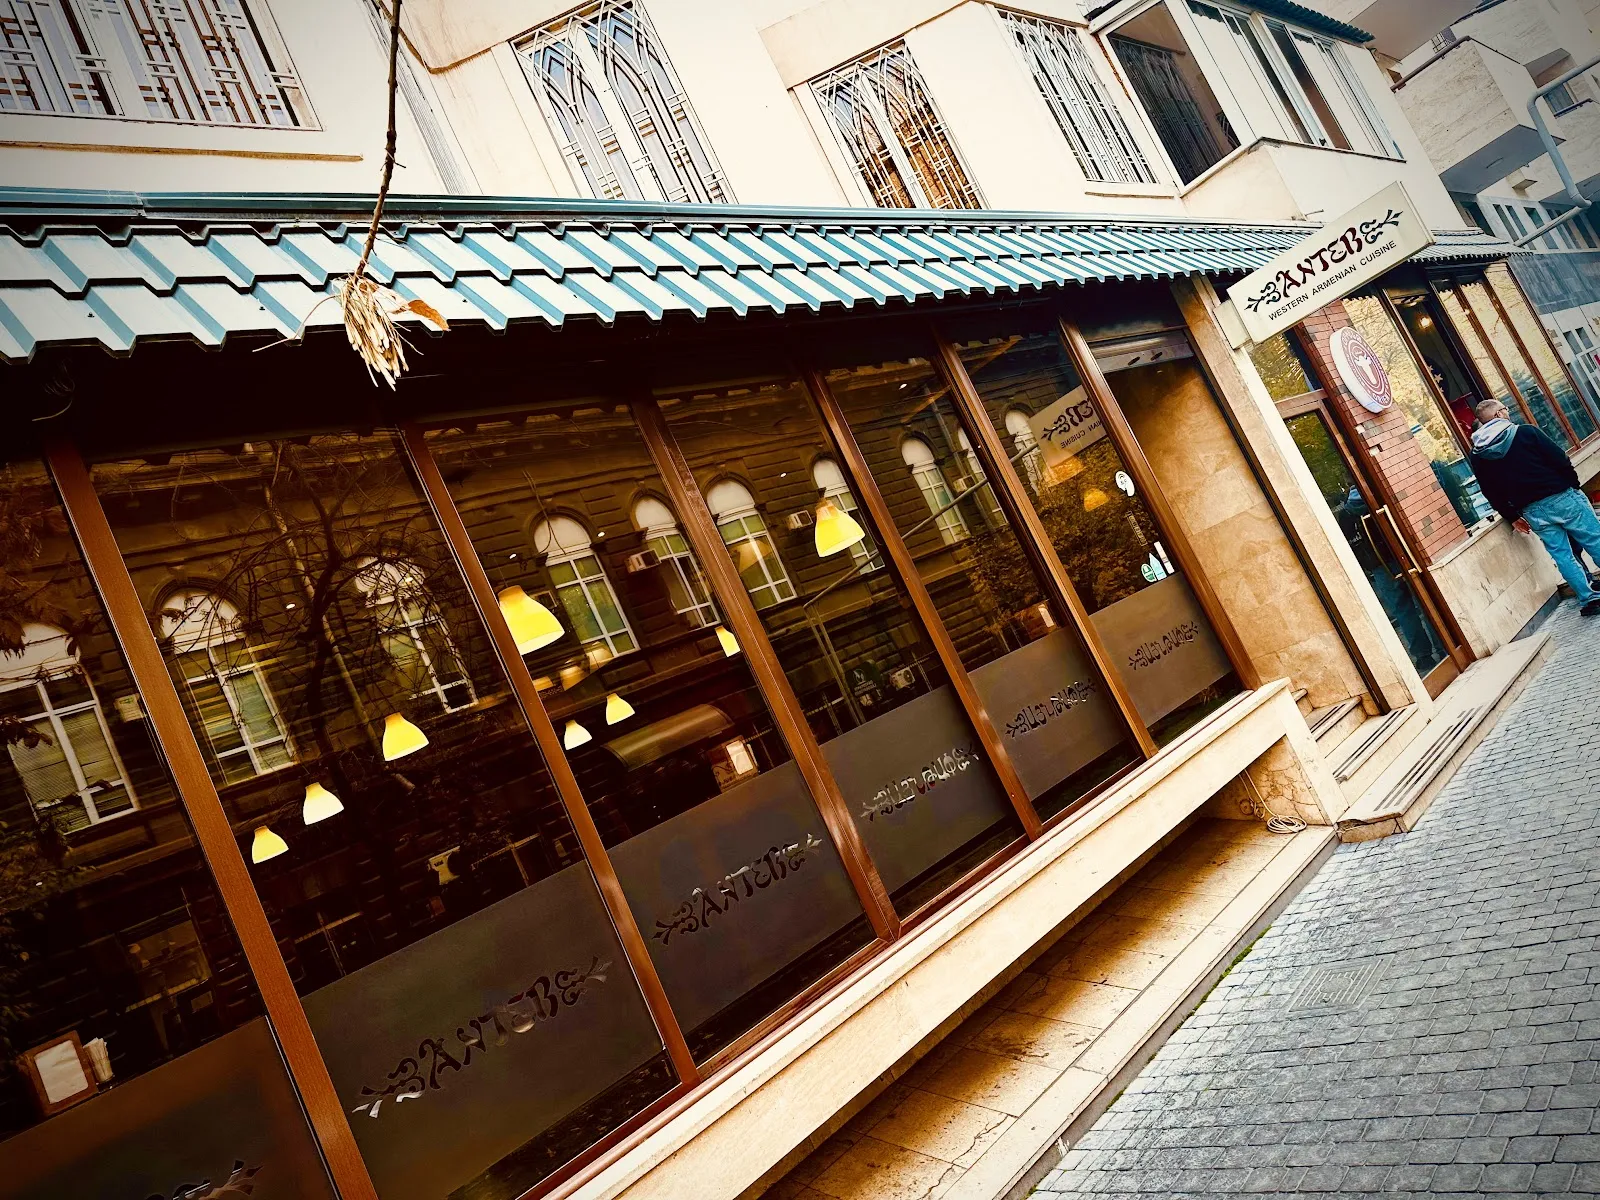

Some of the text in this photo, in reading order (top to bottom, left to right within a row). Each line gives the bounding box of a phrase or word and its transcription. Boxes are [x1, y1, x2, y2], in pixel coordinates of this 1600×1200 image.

[1268, 240, 1397, 321] WESTERN ARMENIAN CUISINE
